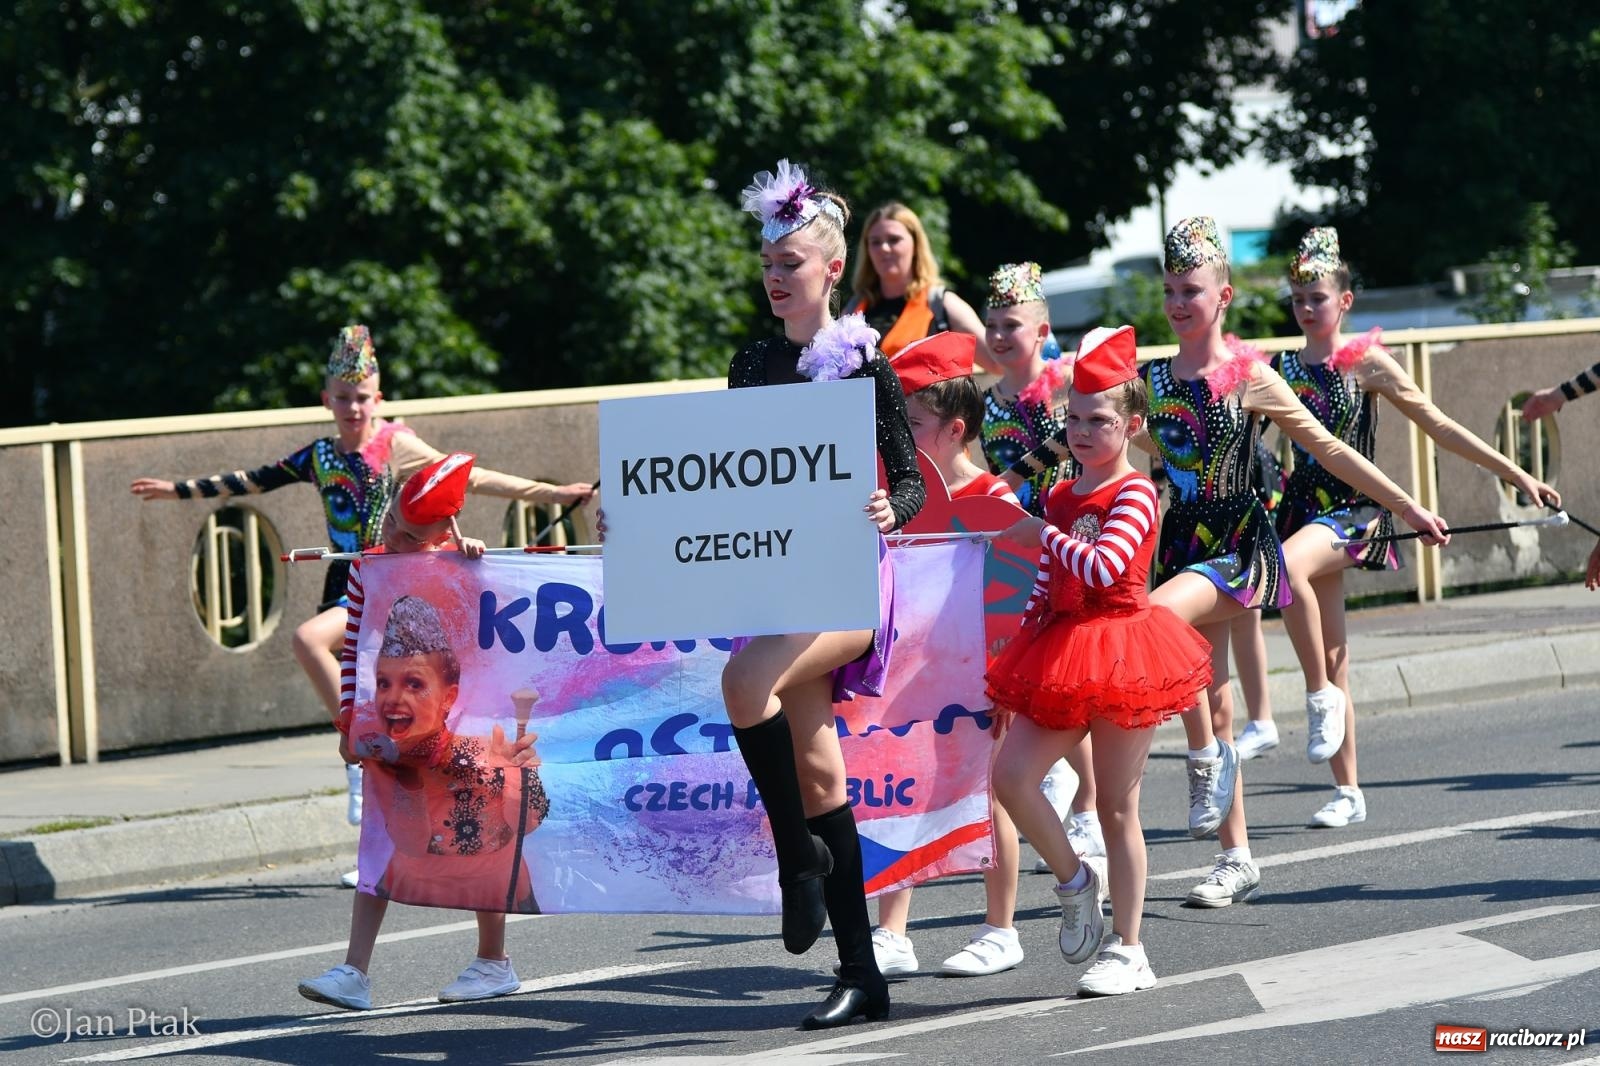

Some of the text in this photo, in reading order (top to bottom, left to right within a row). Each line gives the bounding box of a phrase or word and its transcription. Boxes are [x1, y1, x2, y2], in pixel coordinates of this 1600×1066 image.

[621, 443, 852, 497] KROKODYL
[674, 528, 793, 564] CZECHY
[624, 781, 734, 812] CZECH
